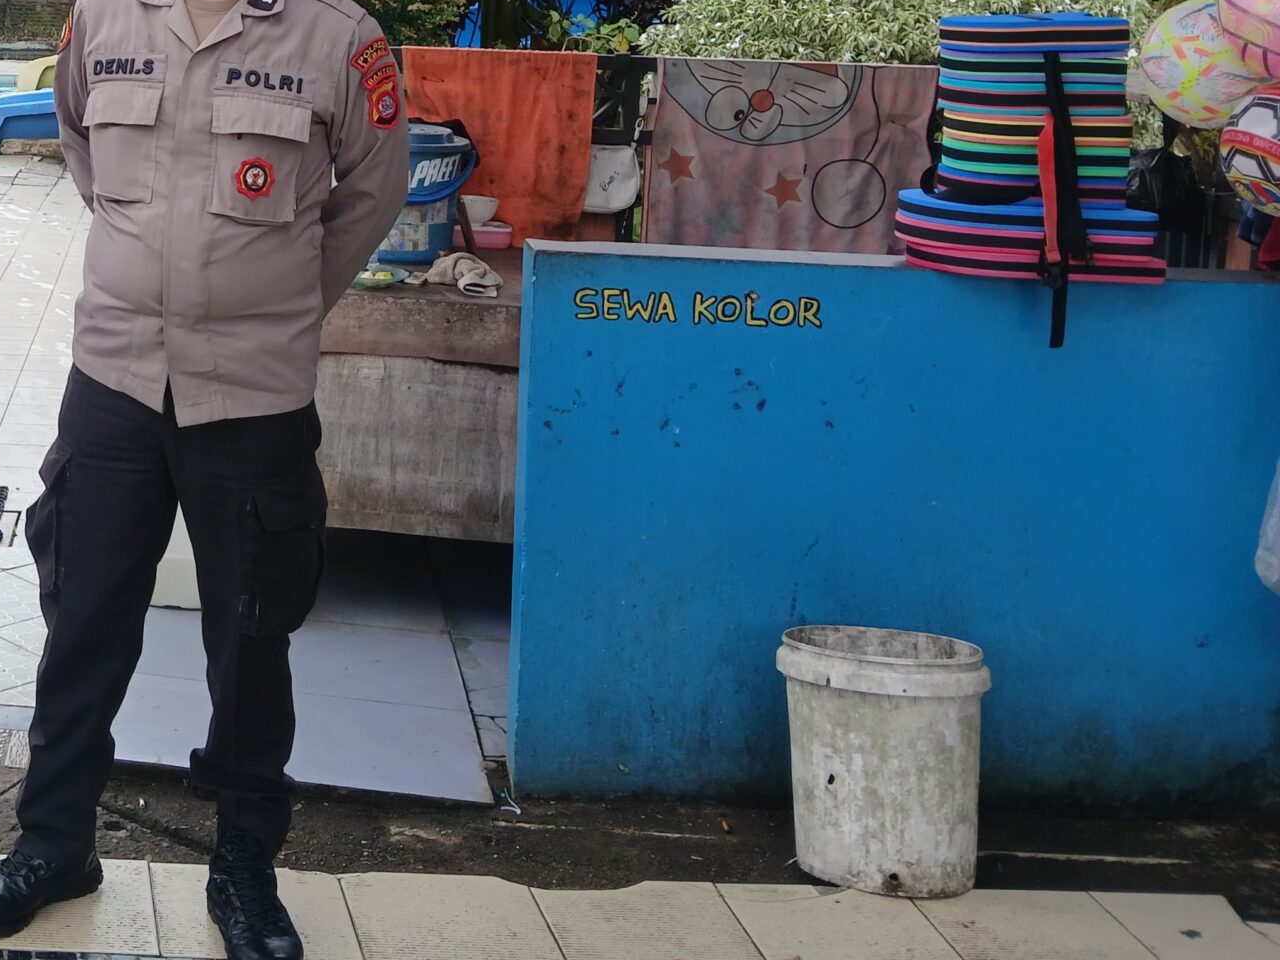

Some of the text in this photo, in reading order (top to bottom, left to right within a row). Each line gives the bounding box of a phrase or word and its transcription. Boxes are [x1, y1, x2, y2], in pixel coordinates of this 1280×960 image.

[93, 58, 155, 76] DENI.S
[225, 68, 304, 94] POLRI
[574, 287, 823, 328] SEWA KOLOR
